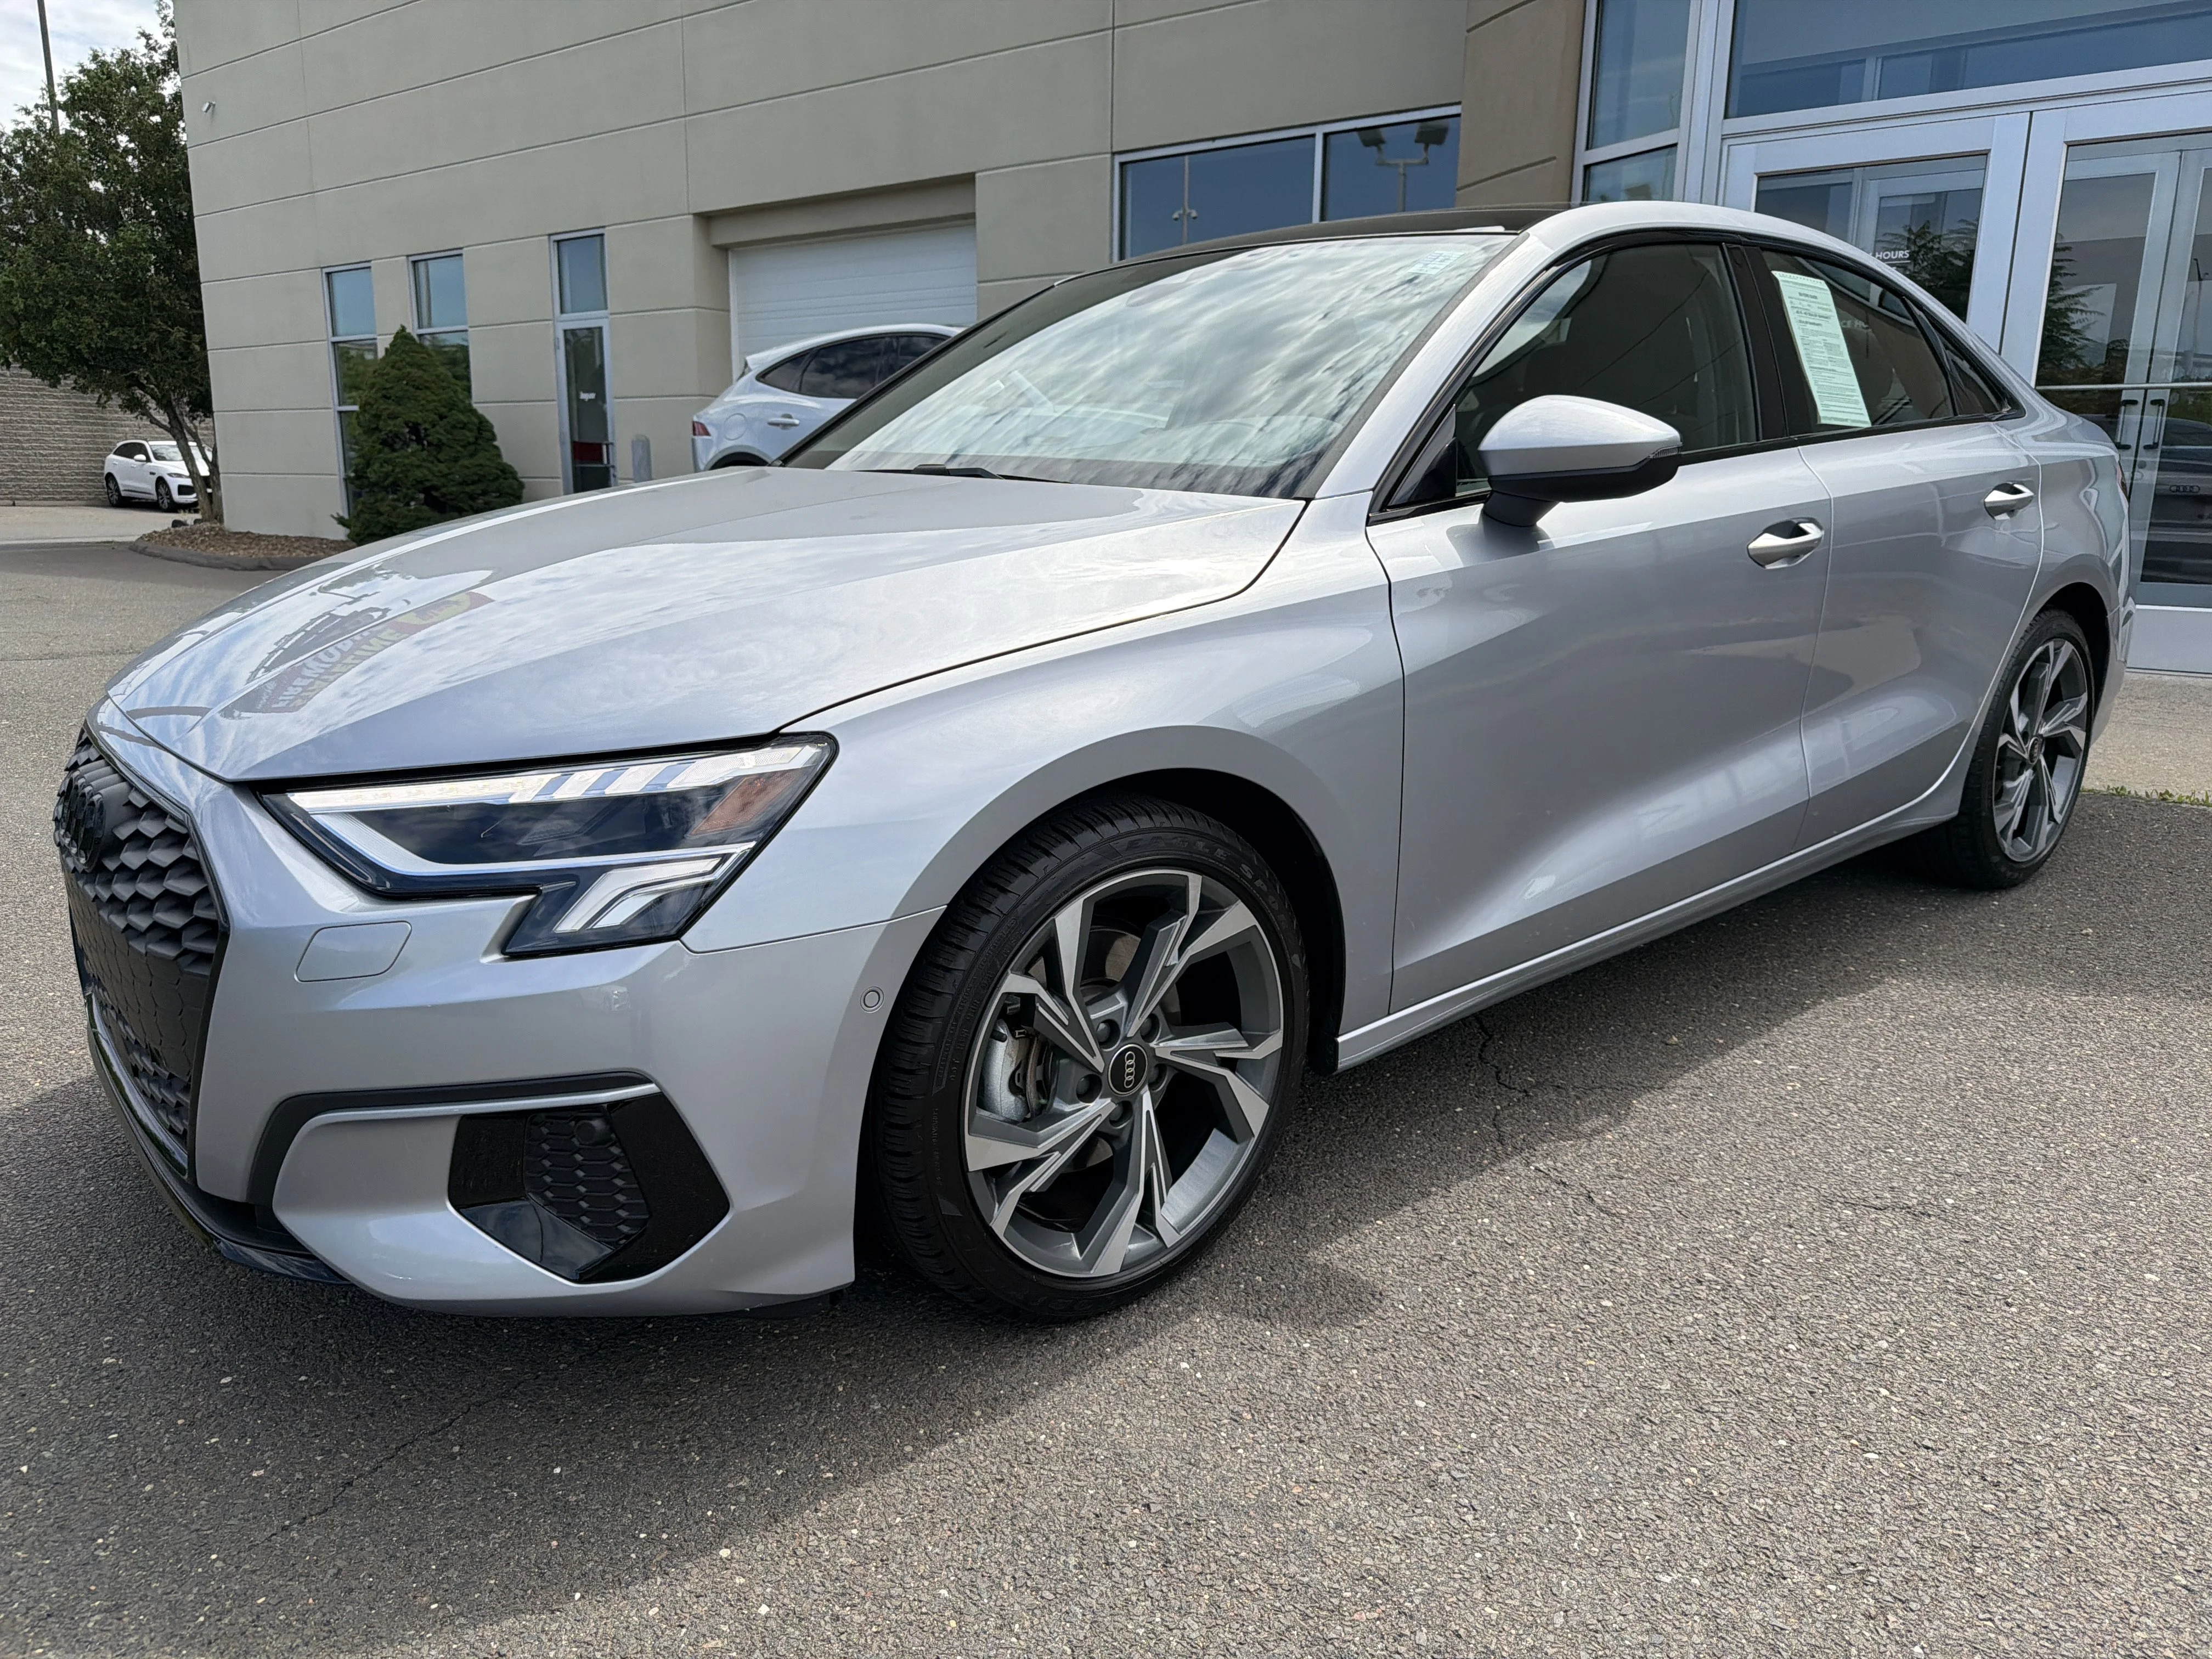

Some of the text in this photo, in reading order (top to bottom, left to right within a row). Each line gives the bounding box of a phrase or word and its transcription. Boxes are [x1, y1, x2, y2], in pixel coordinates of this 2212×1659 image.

[1875, 250, 1910, 259] HOURS
[1126, 835, 1297, 947] EAGLE SPOR
